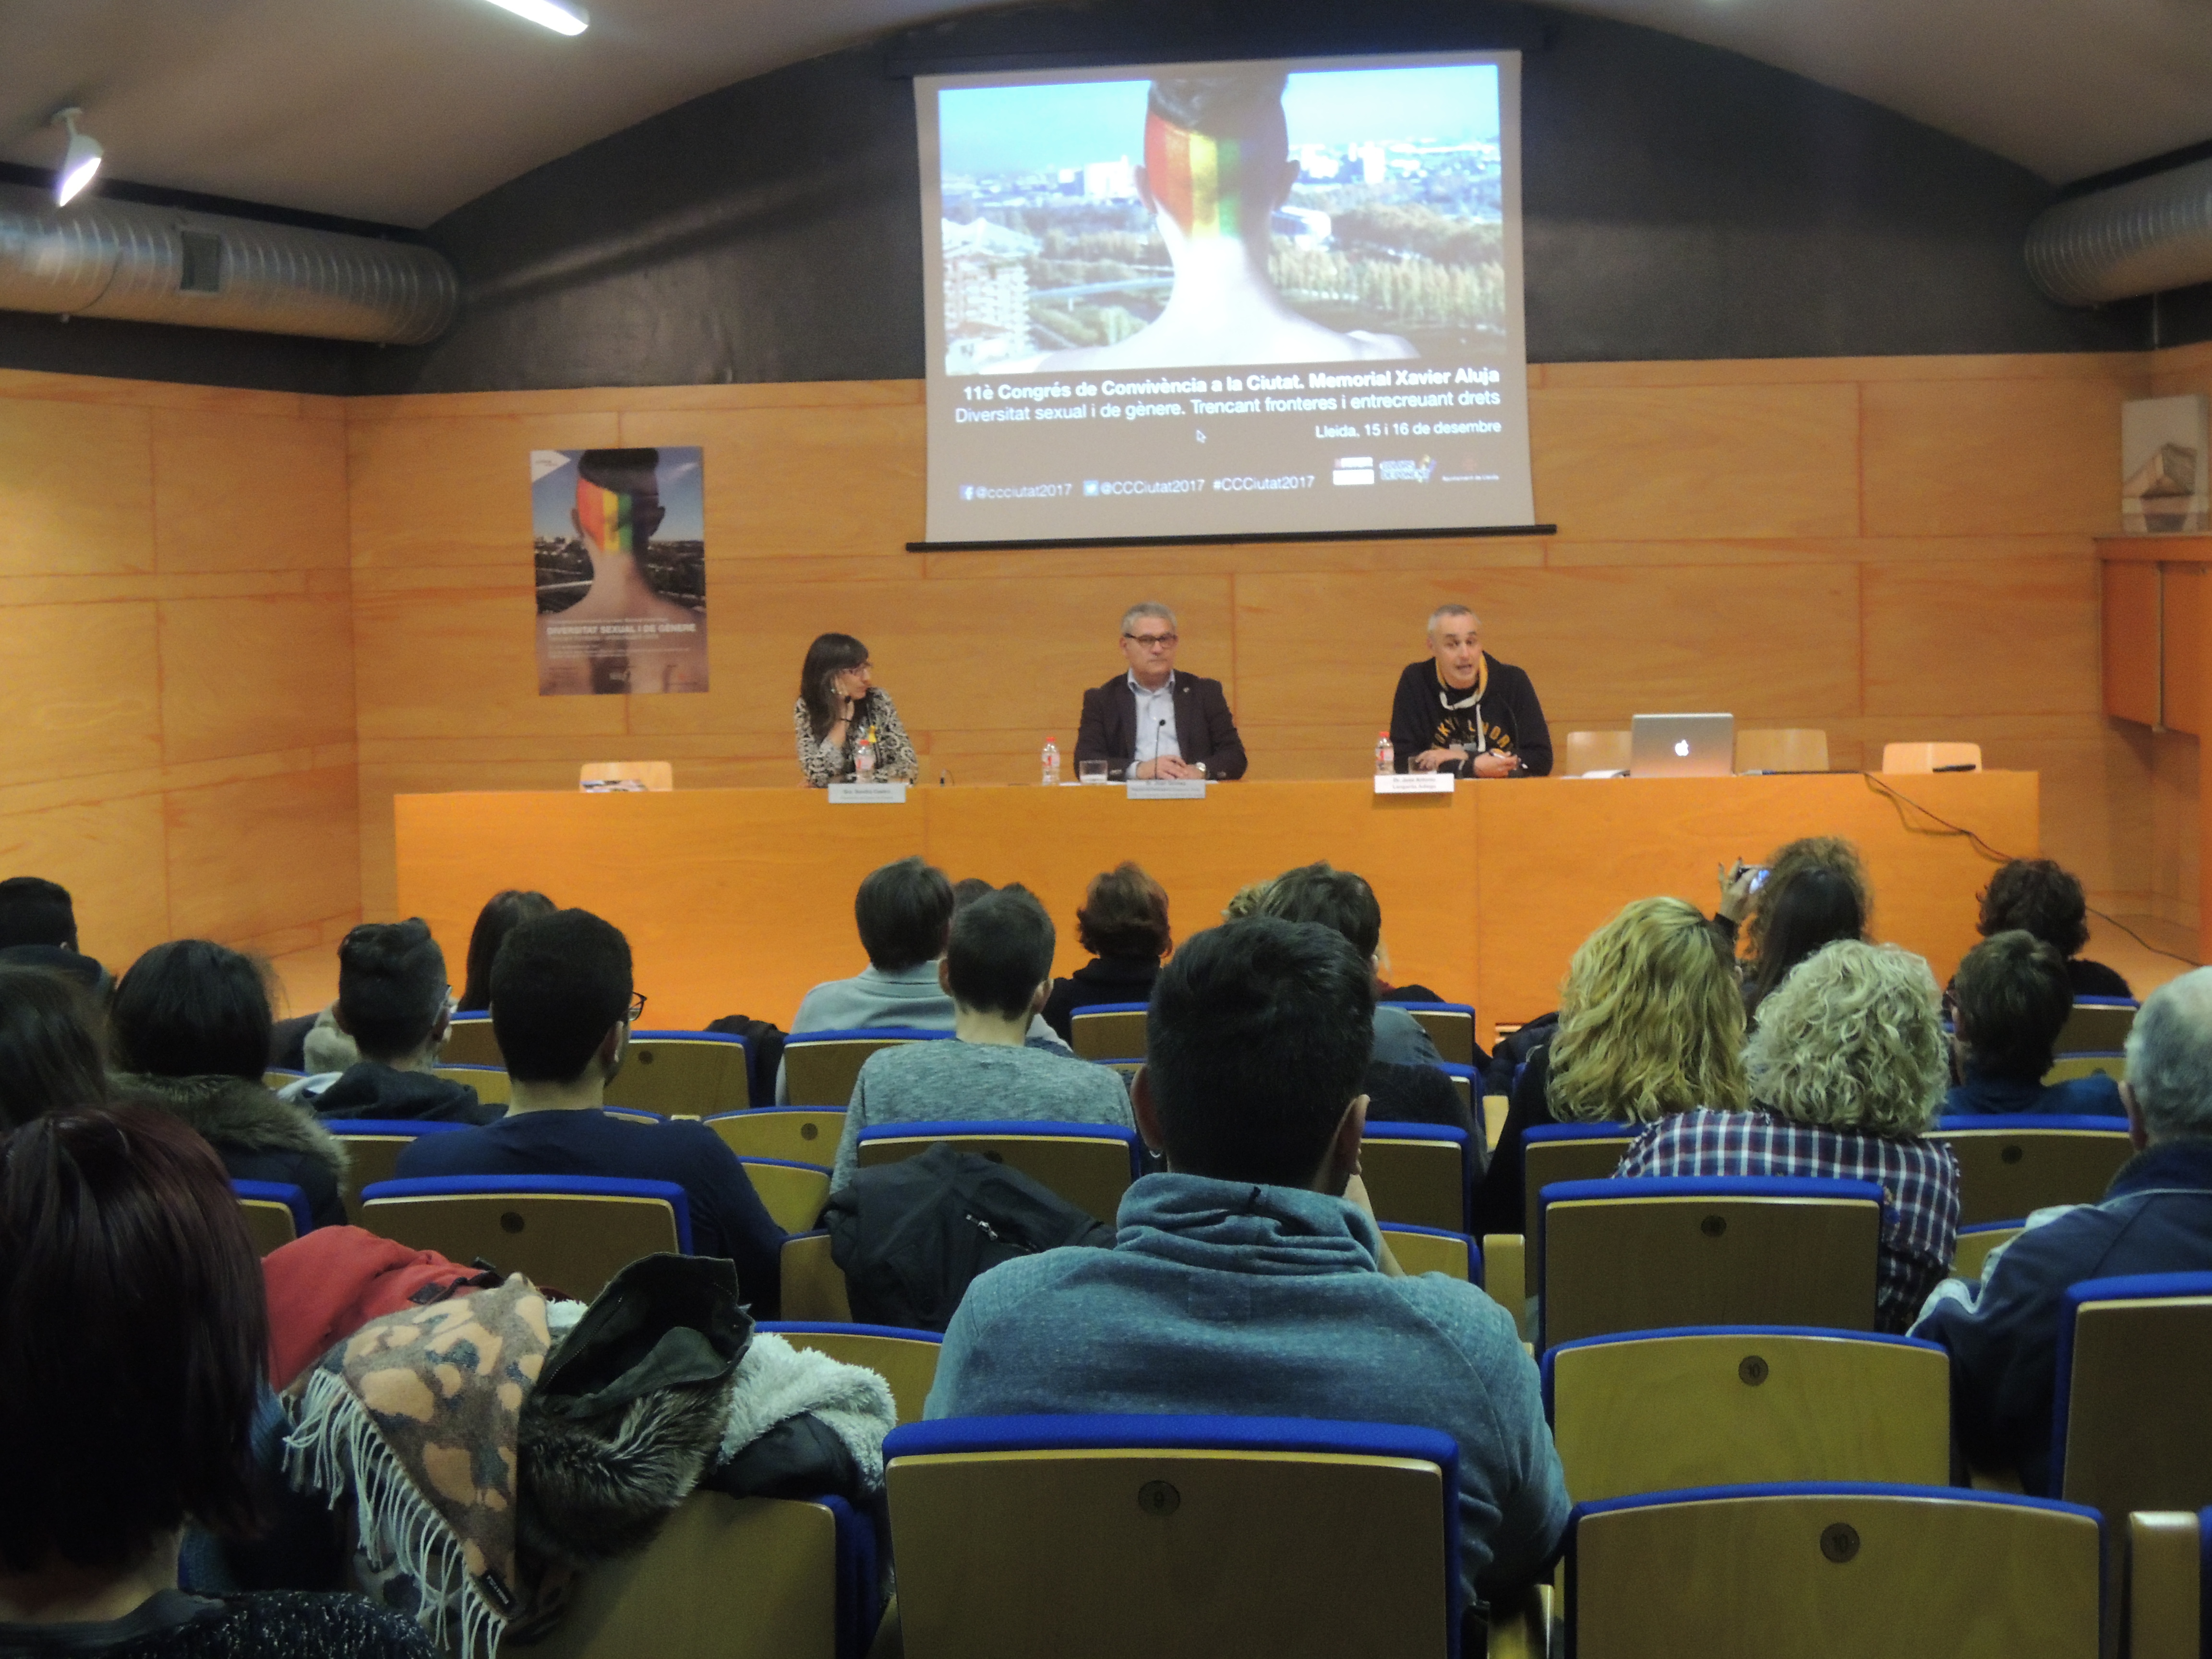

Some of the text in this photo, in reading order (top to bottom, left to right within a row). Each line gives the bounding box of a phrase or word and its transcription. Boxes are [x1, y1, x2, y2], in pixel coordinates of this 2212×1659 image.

[964, 367, 1499, 401] 11è Congrés de Convivència a la Ciutat. Memorial Xavier Aluja
[956, 390, 1501, 422] Diversitat sexual i de gènere. Trencant fronteres i entrecreuant drets
[1365, 423, 1381, 436] 15
[1384, 423, 1388, 435] i
[1393, 422, 1409, 435] 16
[1413, 422, 1431, 434] de
[1433, 420, 1502, 434] desembre
[1213, 475, 1314, 491] #CCCiutat2017
